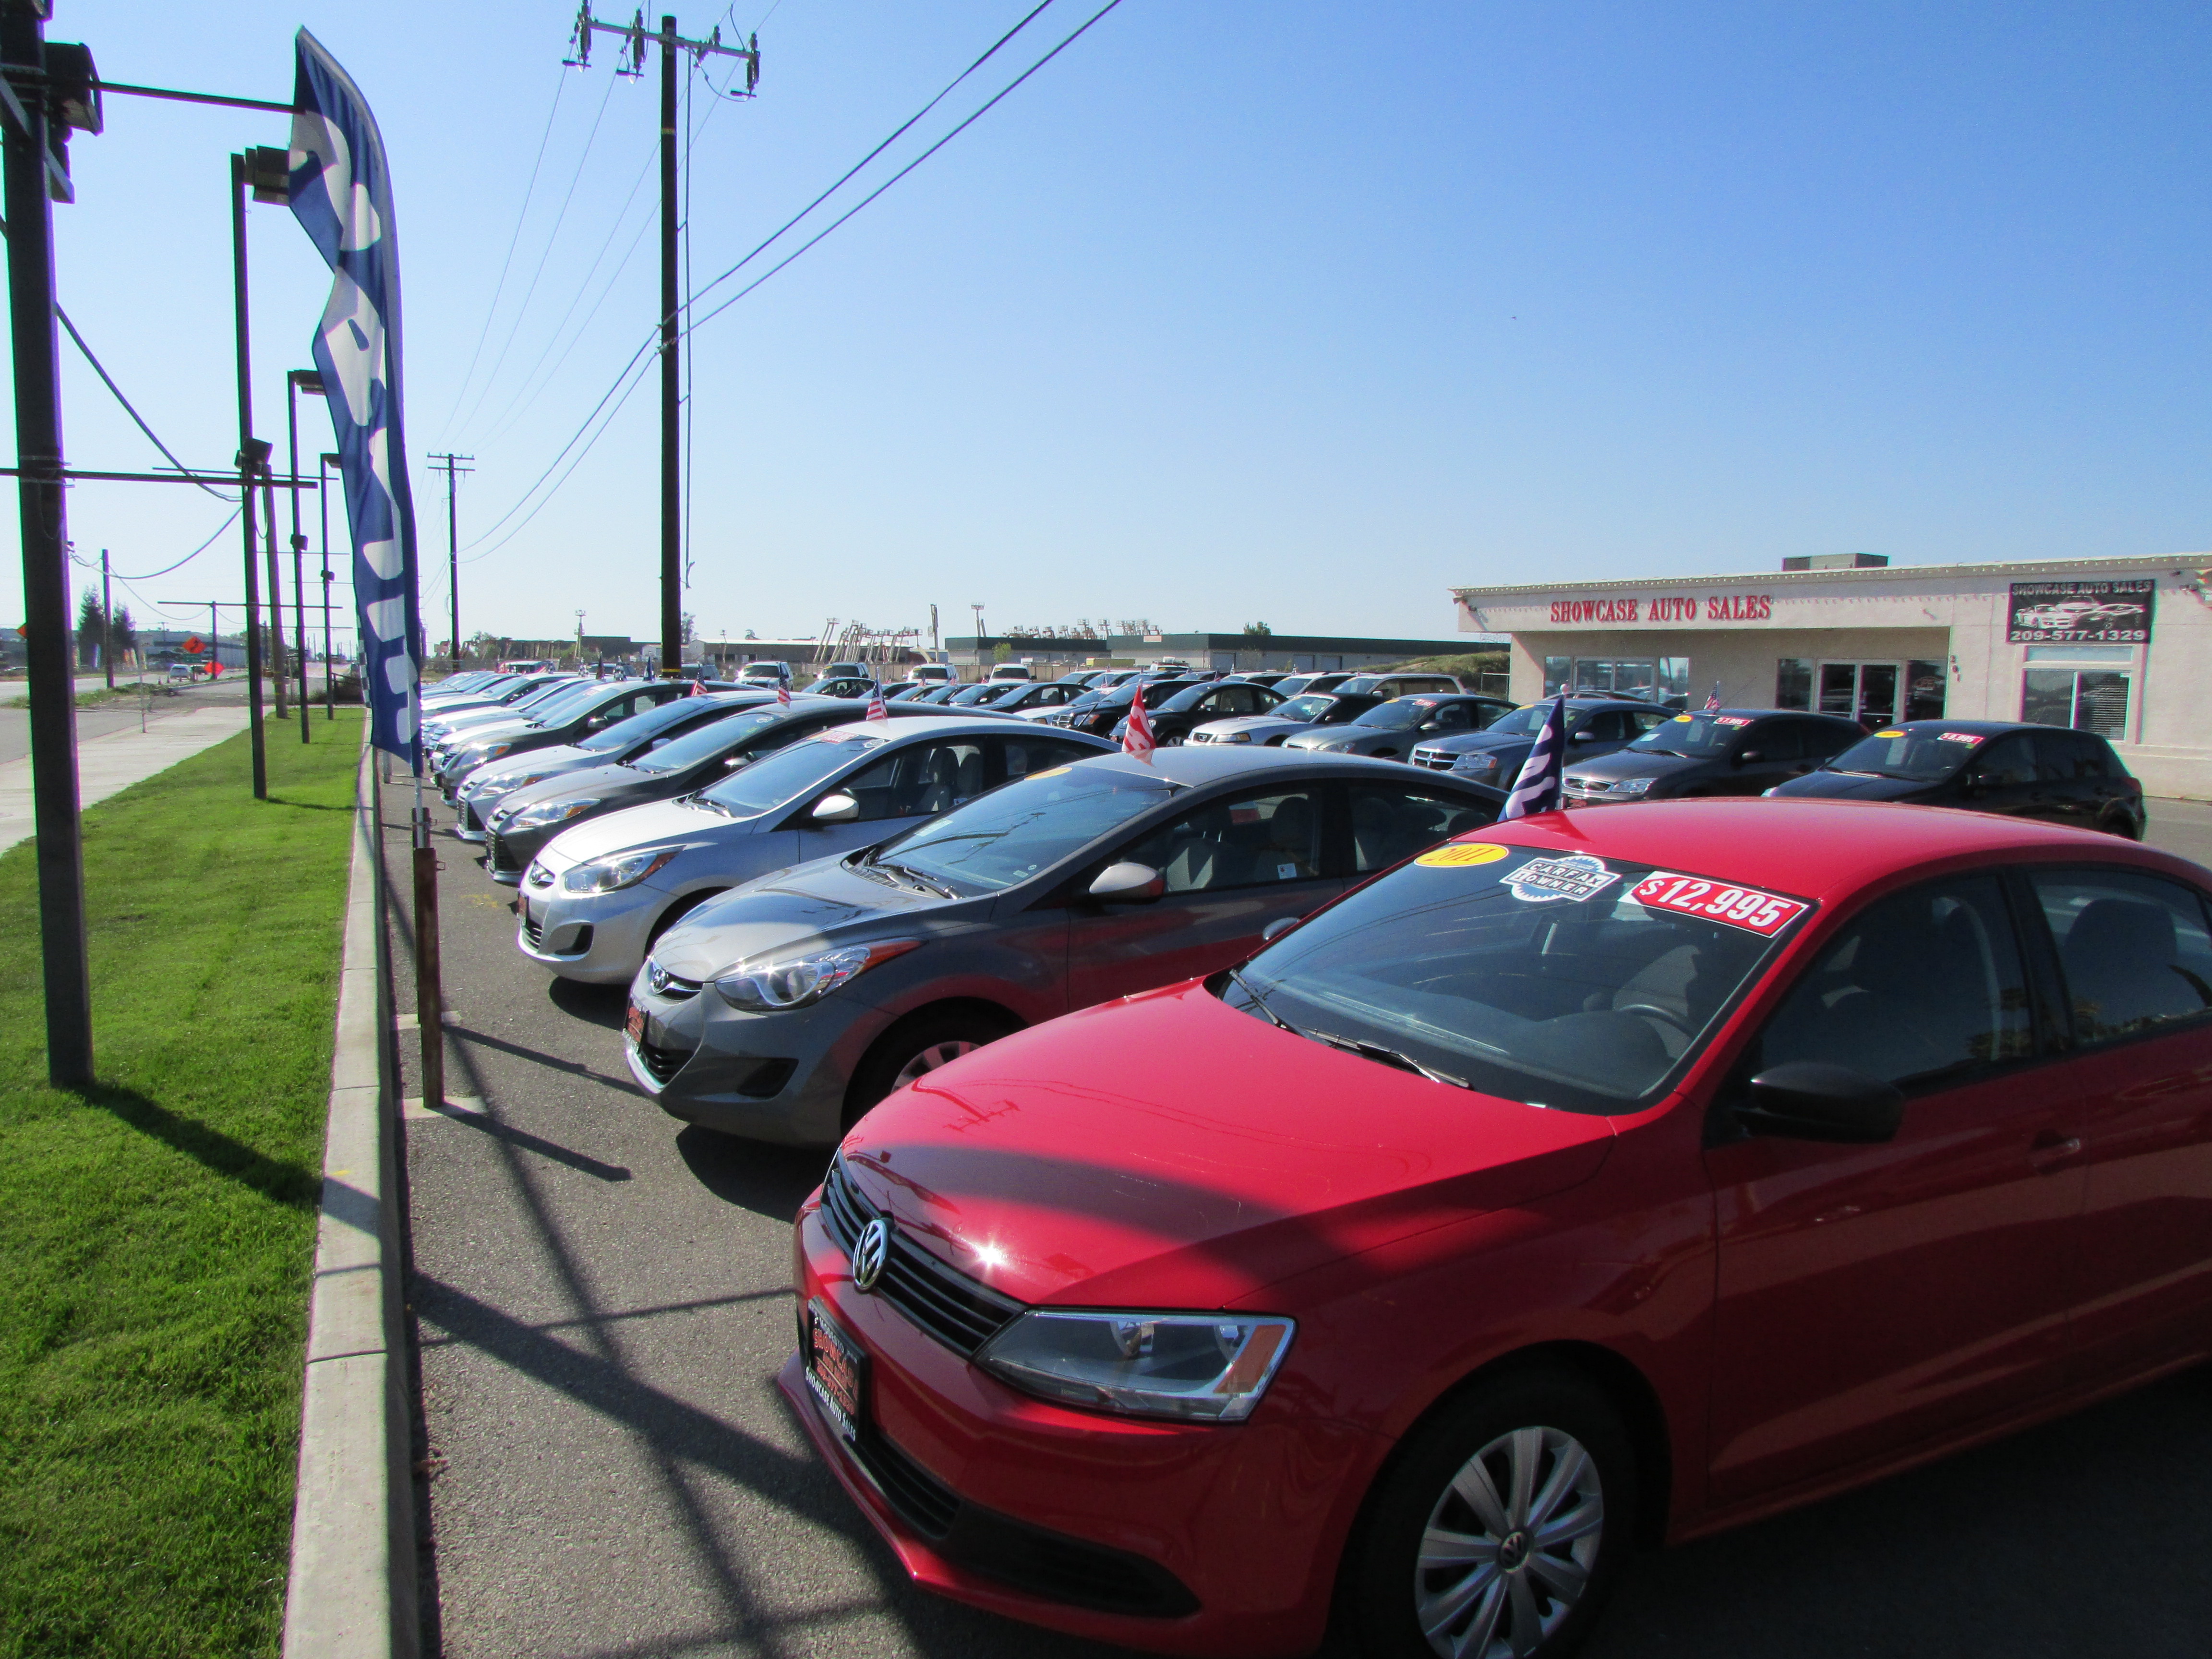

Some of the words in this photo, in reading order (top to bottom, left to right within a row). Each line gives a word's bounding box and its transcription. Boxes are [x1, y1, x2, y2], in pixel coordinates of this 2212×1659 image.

[2012, 583, 2076, 595] SHOWCASE
[2077, 582, 2109, 594] AUTO
[2112, 580, 2153, 593] SALES
[1551, 599, 1637, 622] SHOWCASE
[1648, 597, 1697, 621] AUTO
[1707, 595, 1771, 620] SALES
[2009, 630, 2146, 641] 209-577-1329
[1529, 864, 1602, 885] CARFAX
[1638, 879, 1792, 927] $12,995
[805, 1366, 830, 1407] SHOWCASE
[829, 1396, 842, 1422] AUTO
[842, 1412, 856, 1442] SALES
